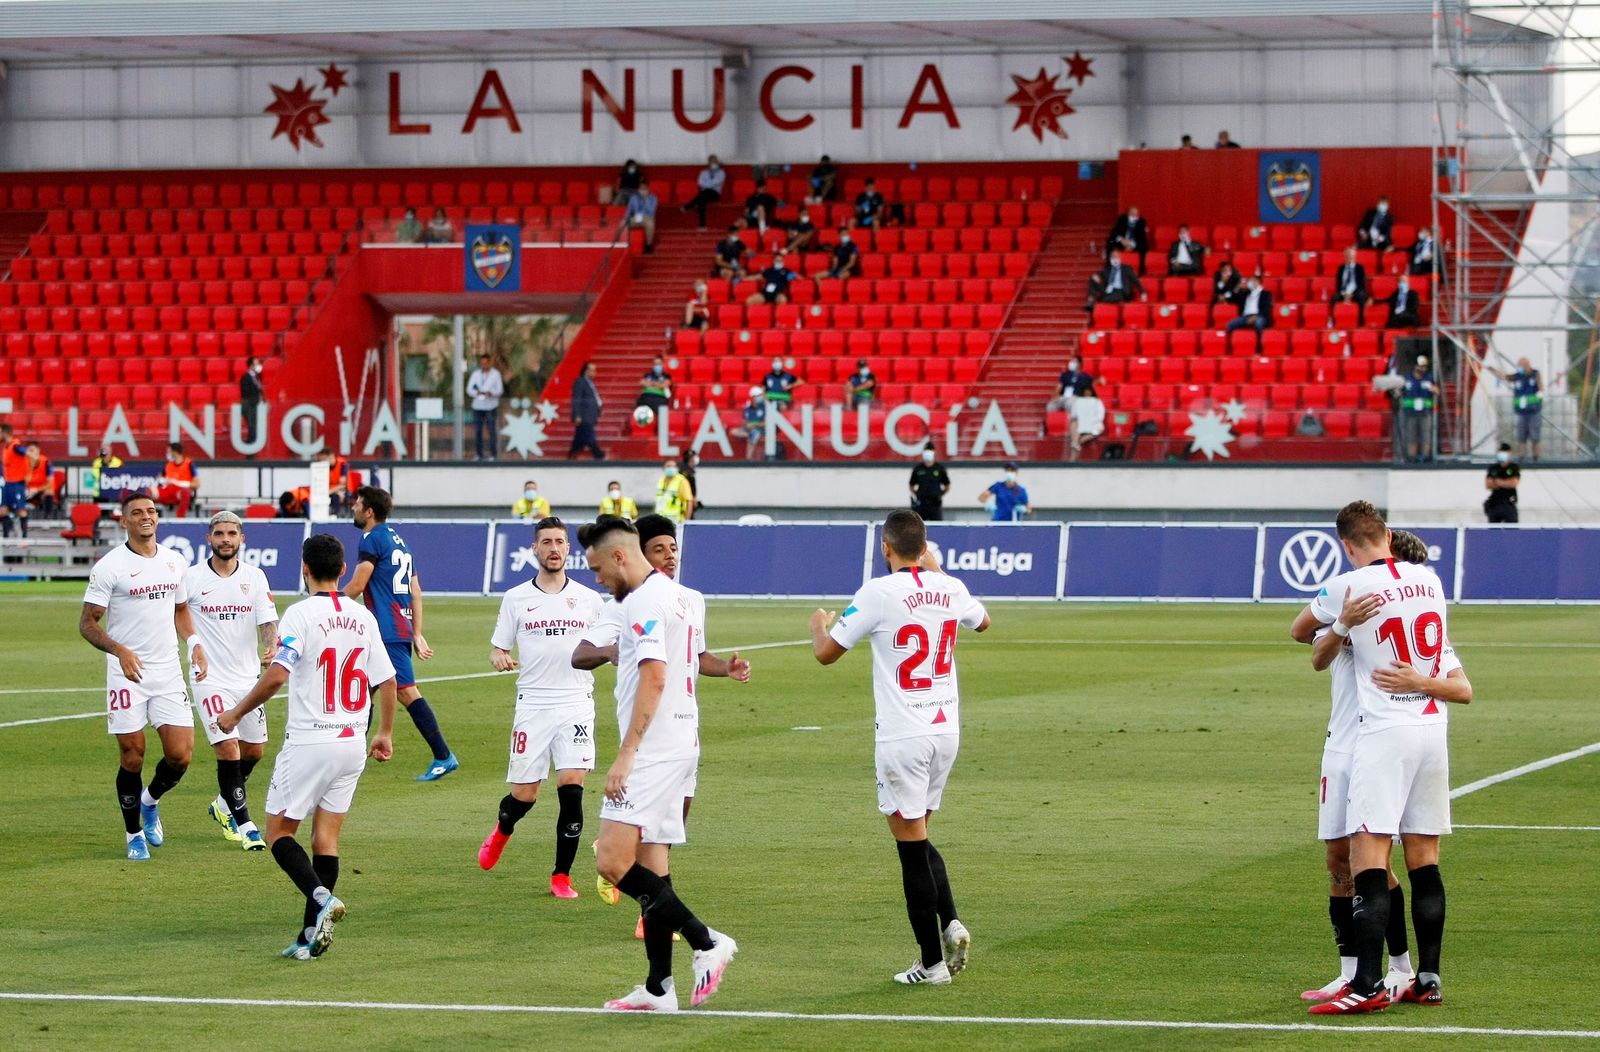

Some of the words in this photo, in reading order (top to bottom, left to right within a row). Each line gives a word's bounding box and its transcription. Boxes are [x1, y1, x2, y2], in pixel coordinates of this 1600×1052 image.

[388, 69, 522, 135] LA
[581, 63, 962, 134] NUCIA
[68, 402, 140, 457] LA
[658, 401, 734, 457] LA
[947, 546, 1032, 576] LaLiga
[148, 591, 166, 600] BET
[902, 591, 951, 615] JORDAN
[1397, 584, 1435, 603] JONG
[200, 605, 253, 613] MARATHON
[219, 613, 237, 621] BET
[319, 616, 366, 637] J.NAVAS
[524, 619, 586, 631] MARATHON
[545, 628, 567, 637] BET
[893, 619, 958, 692] 24
[1375, 611, 1443, 678] 19
[316, 647, 368, 714] 16
[109, 688, 132, 711] 20
[202, 694, 225, 718] 10
[512, 730, 528, 755] 18
